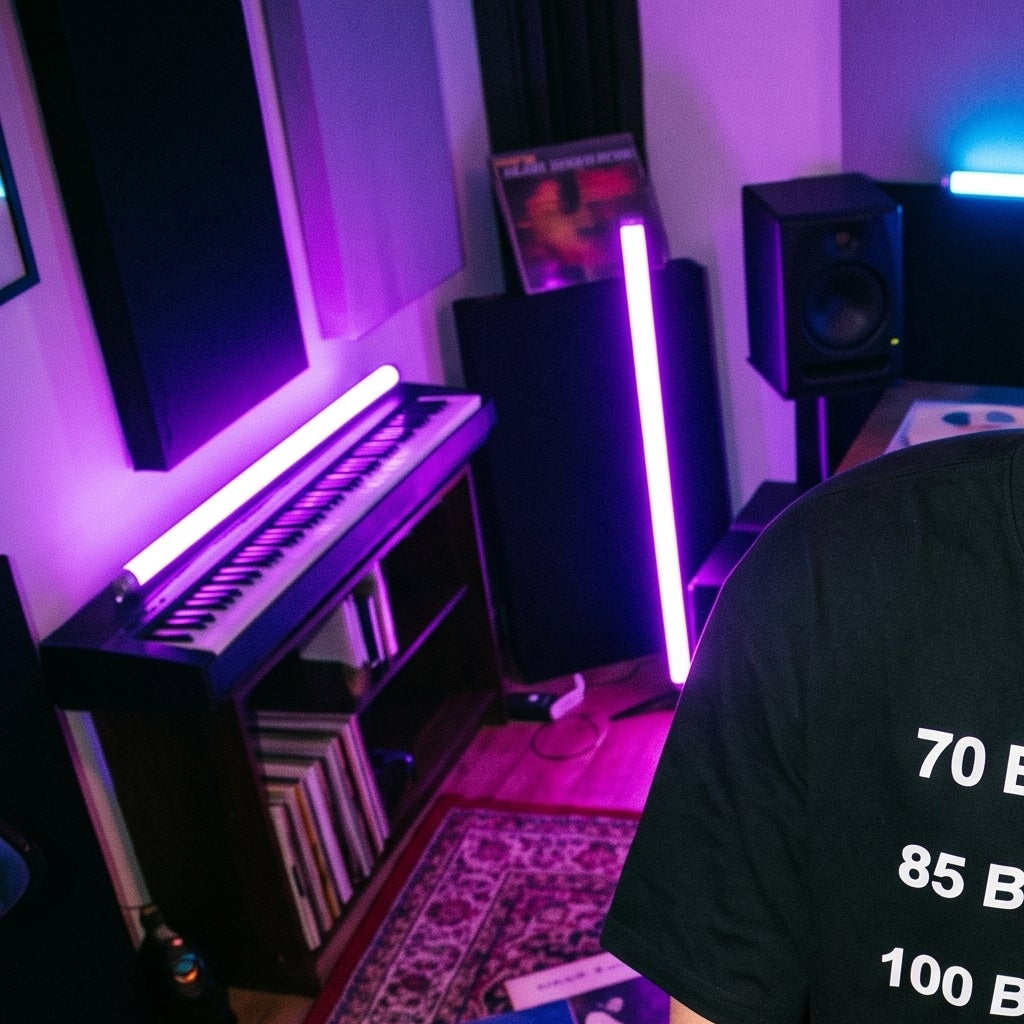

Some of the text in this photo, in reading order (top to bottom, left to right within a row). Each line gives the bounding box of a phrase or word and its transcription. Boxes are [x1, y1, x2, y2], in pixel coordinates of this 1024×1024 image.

[917, 727, 986, 787] 70
[898, 844, 966, 899] 85
[881, 947, 973, 1007] 100
